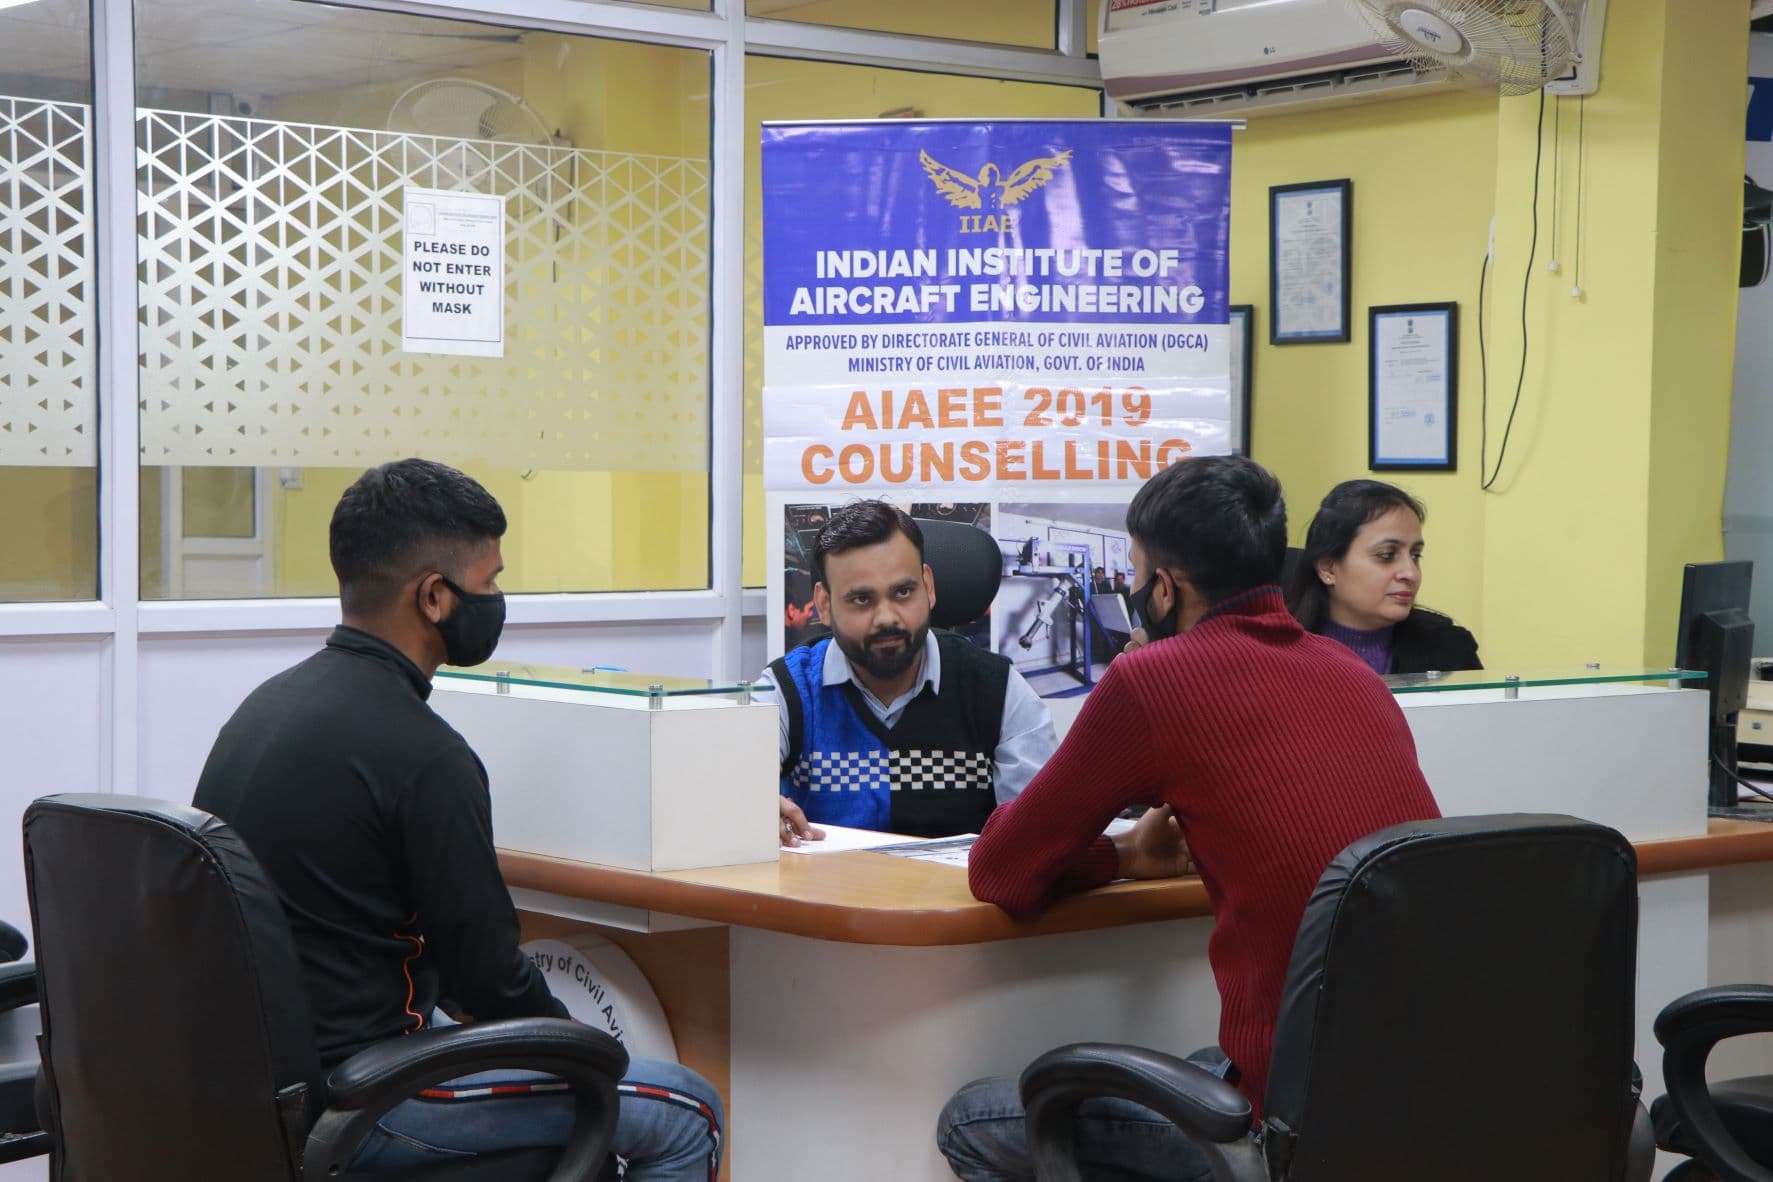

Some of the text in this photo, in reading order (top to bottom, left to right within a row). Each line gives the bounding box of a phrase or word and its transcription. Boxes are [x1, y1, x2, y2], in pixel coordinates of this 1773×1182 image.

[960, 215, 1013, 234] IIAE
[414, 241, 490, 256] PLEASE DO
[413, 261, 491, 276] NOT ENTER
[817, 248, 1179, 278] INDIAN INSTITUTE OF
[420, 281, 485, 295] WITHOUT
[432, 302, 472, 314] MASK
[790, 285, 1205, 315] AIRCRAFT ENGINEERING
[786, 331, 1208, 352] APPROVED BY DIRECTORATE GENERAL OF CIVIL AVIATION (DGCA)
[848, 354, 1145, 373] MINISTRY OF CIVIL AVIATION, GOVT. OF INDIA
[841, 386, 1152, 431] AIAEE 2019
[558, 957, 572, 973] of
[575, 964, 605, 1004] Civil
